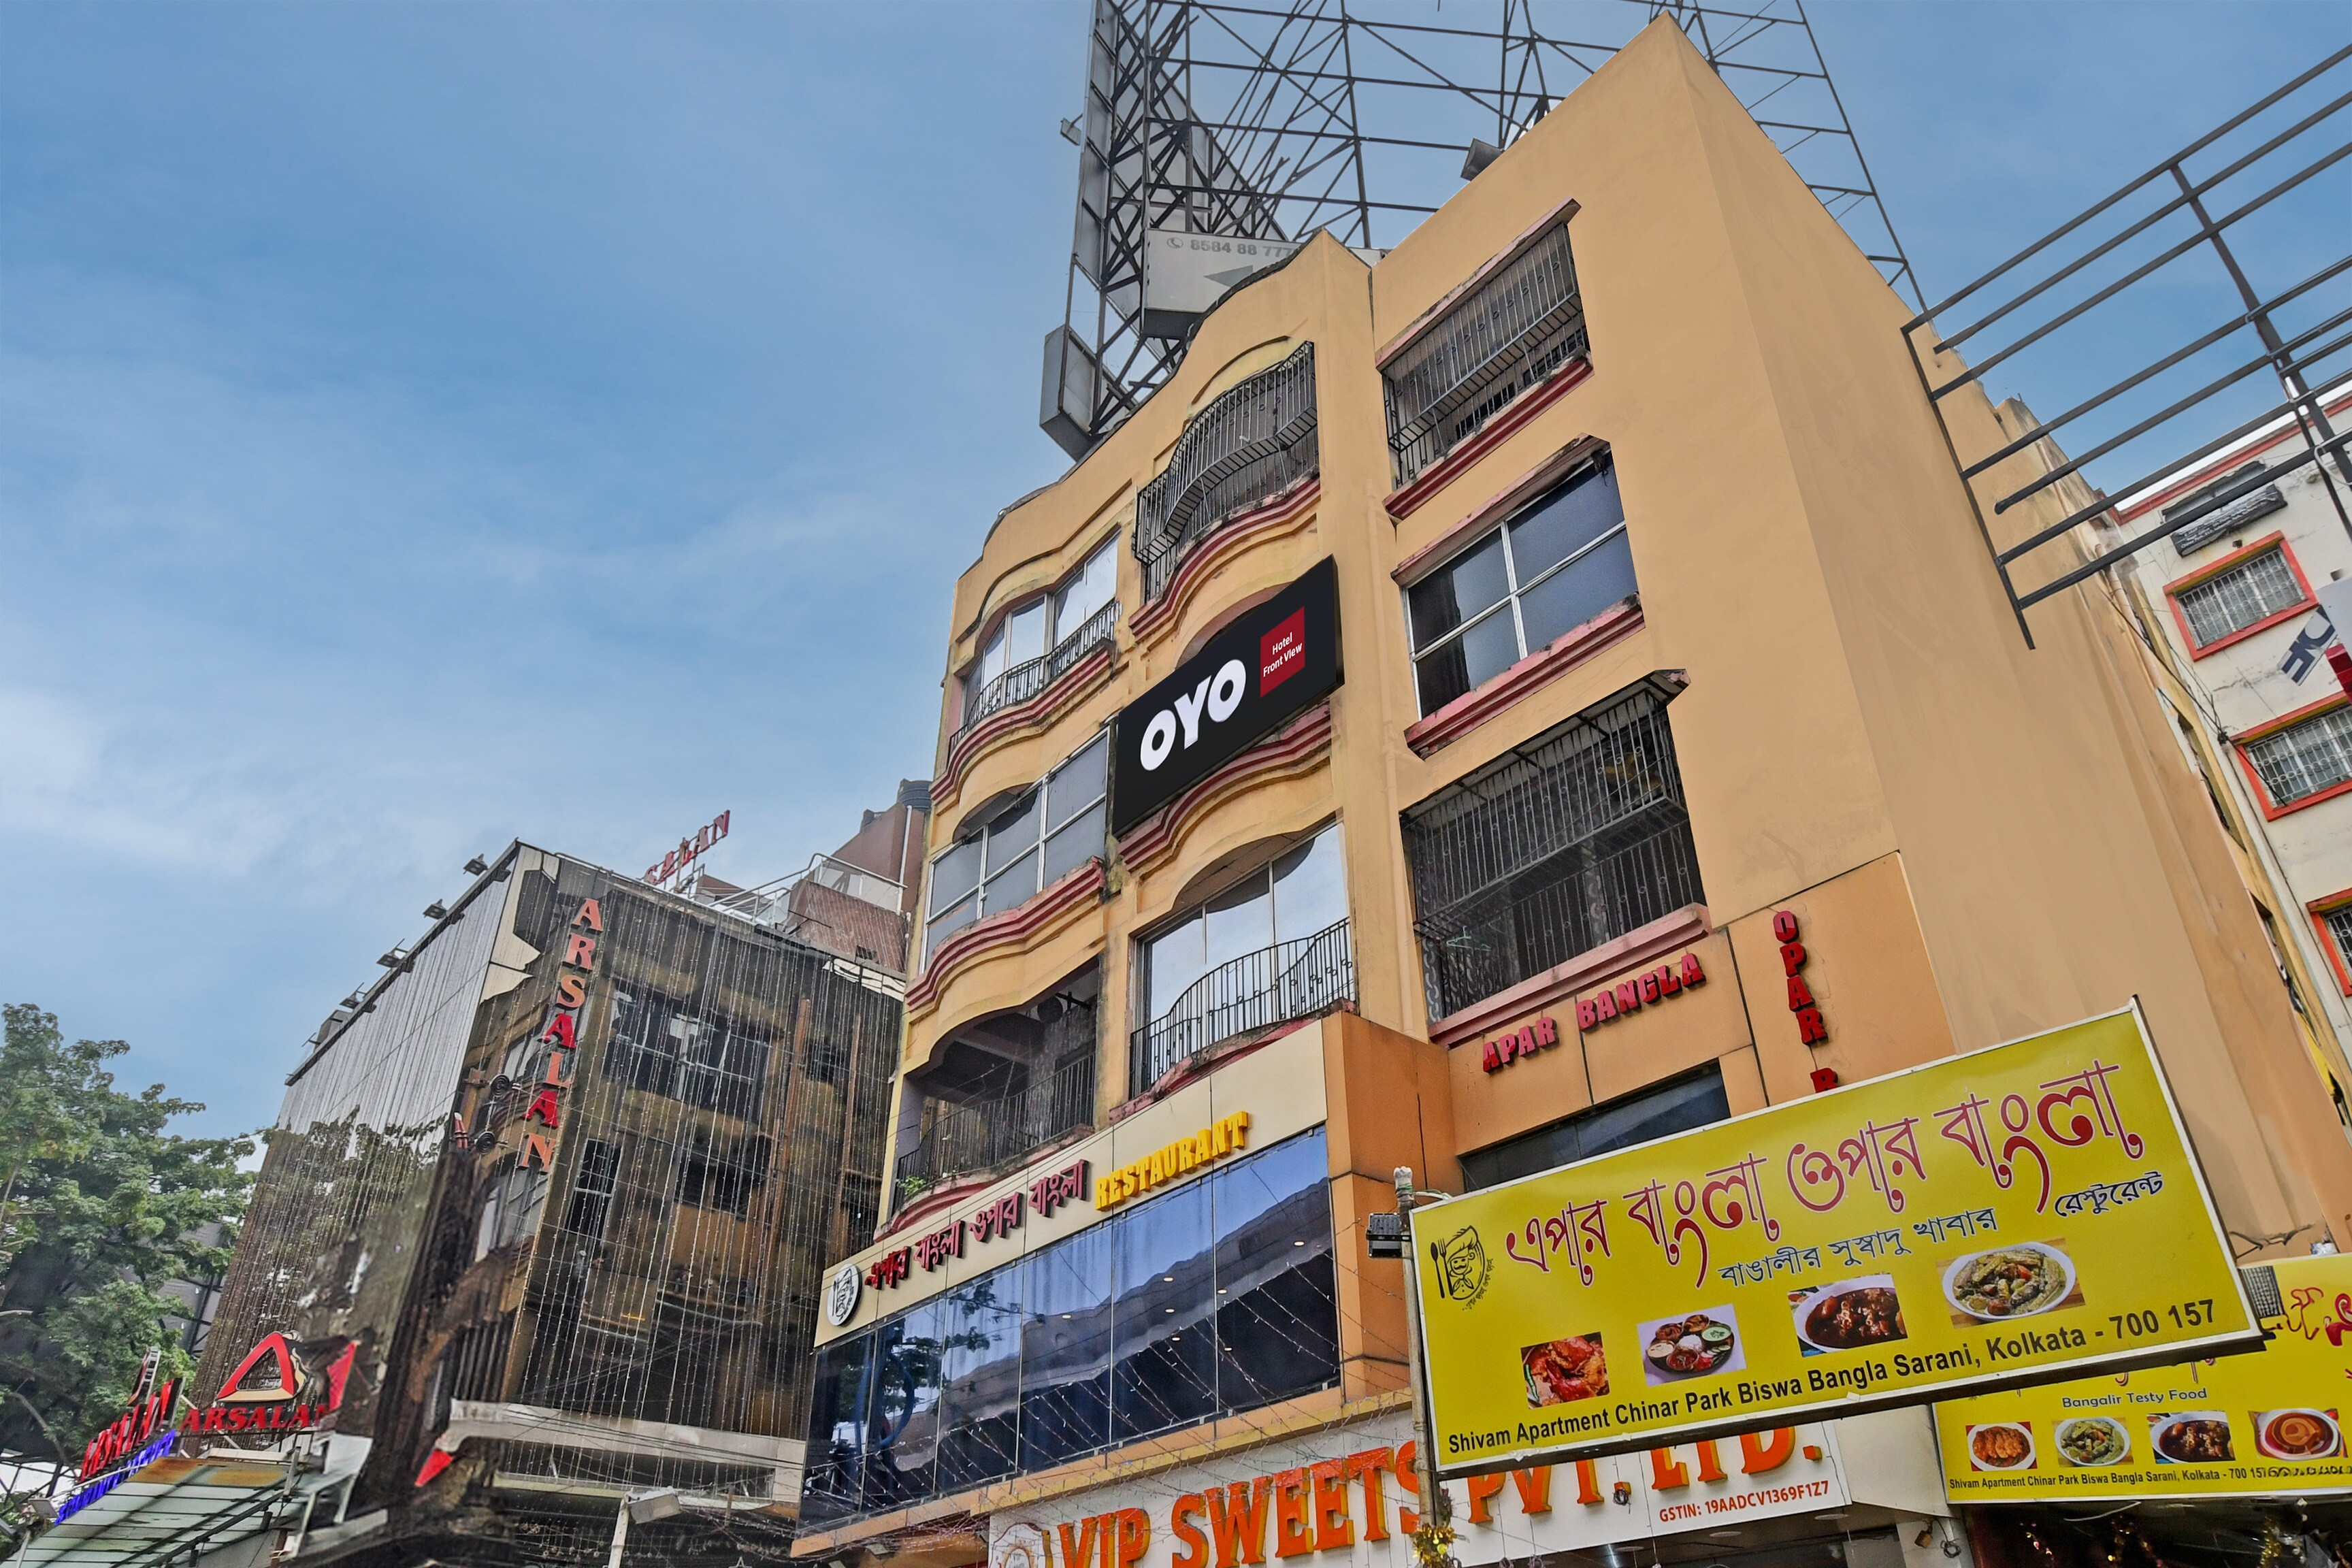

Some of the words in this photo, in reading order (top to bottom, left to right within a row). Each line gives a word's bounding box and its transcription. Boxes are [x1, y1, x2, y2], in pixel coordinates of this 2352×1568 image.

[1190, 240, 1232, 253] 8584
[1237, 244, 1258, 256] 88
[1263, 655, 1284, 678] Front
[1284, 642, 1303, 662] View
[1272, 631, 1293, 655] Hotel
[1140, 658, 1247, 771] OYO
[1482, 1016, 1559, 1074] APAR
[1575, 953, 1706, 1032] BANGLA
[1773, 910, 1829, 1045] OPAR
[519, 898, 604, 1176] ARSALAN
[1095, 1111, 1248, 1212] RESTAURANT
[1505, 1199, 1612, 1288] এপার
[1622, 1152, 1780, 1288] বাংলা
[1786, 1116, 1927, 1214] ওপার
[1933, 1058, 2145, 1214] বাংলা
[864, 1245, 912, 1290] এপার
[914, 1219, 966, 1273] বাংলা
[968, 1192, 1024, 1243] ওপার
[1028, 1158, 1090, 1218] বাংলা
[1717, 1245, 1823, 1288] বাঙালীর
[1912, 1207, 1998, 1244] খাবার
[1448, 1428, 1512, 1454] Shivam
[1516, 1408, 1611, 1447] Apartment
[1615, 1391, 1680, 1426] Chinar
[1685, 1387, 1733, 1415] Park
[1737, 1377, 1803, 1405] Biswa
[1808, 1360, 1887, 1392] Bangla
[1893, 1343, 1981, 1377] Sarani,
[1985, 1327, 2087, 1363] Kolkata
[2109, 1309, 2159, 1341] 700
[2168, 1298, 2216, 1330] 157
[2062, 1394, 2122, 1409] Bangalir
[2126, 1392, 2163, 1404] Testy
[2168, 1388, 2208, 1401] Food
[1058, 1507, 1151, 1568] VIP
[1171, 1439, 1421, 1568] SWEETS
[1659, 1503, 1702, 1522] GSTIN:
[1704, 1480, 1829, 1514] 19AADCV1369F1Z7
[1949, 1477, 1980, 1489] Shivam
[1982, 1476, 2025, 1490] Apartment
[2027, 1475, 2056, 1486] Chinar
[2059, 1473, 2079, 1485] Park
[2081, 1473, 2108, 1484] Biswa
[2110, 1471, 2143, 1484] Bangla
[2146, 1470, 2180, 1483] Sarani,
[2183, 1468, 2220, 1481] Kolkata
[2229, 1467, 2247, 1479] 700
